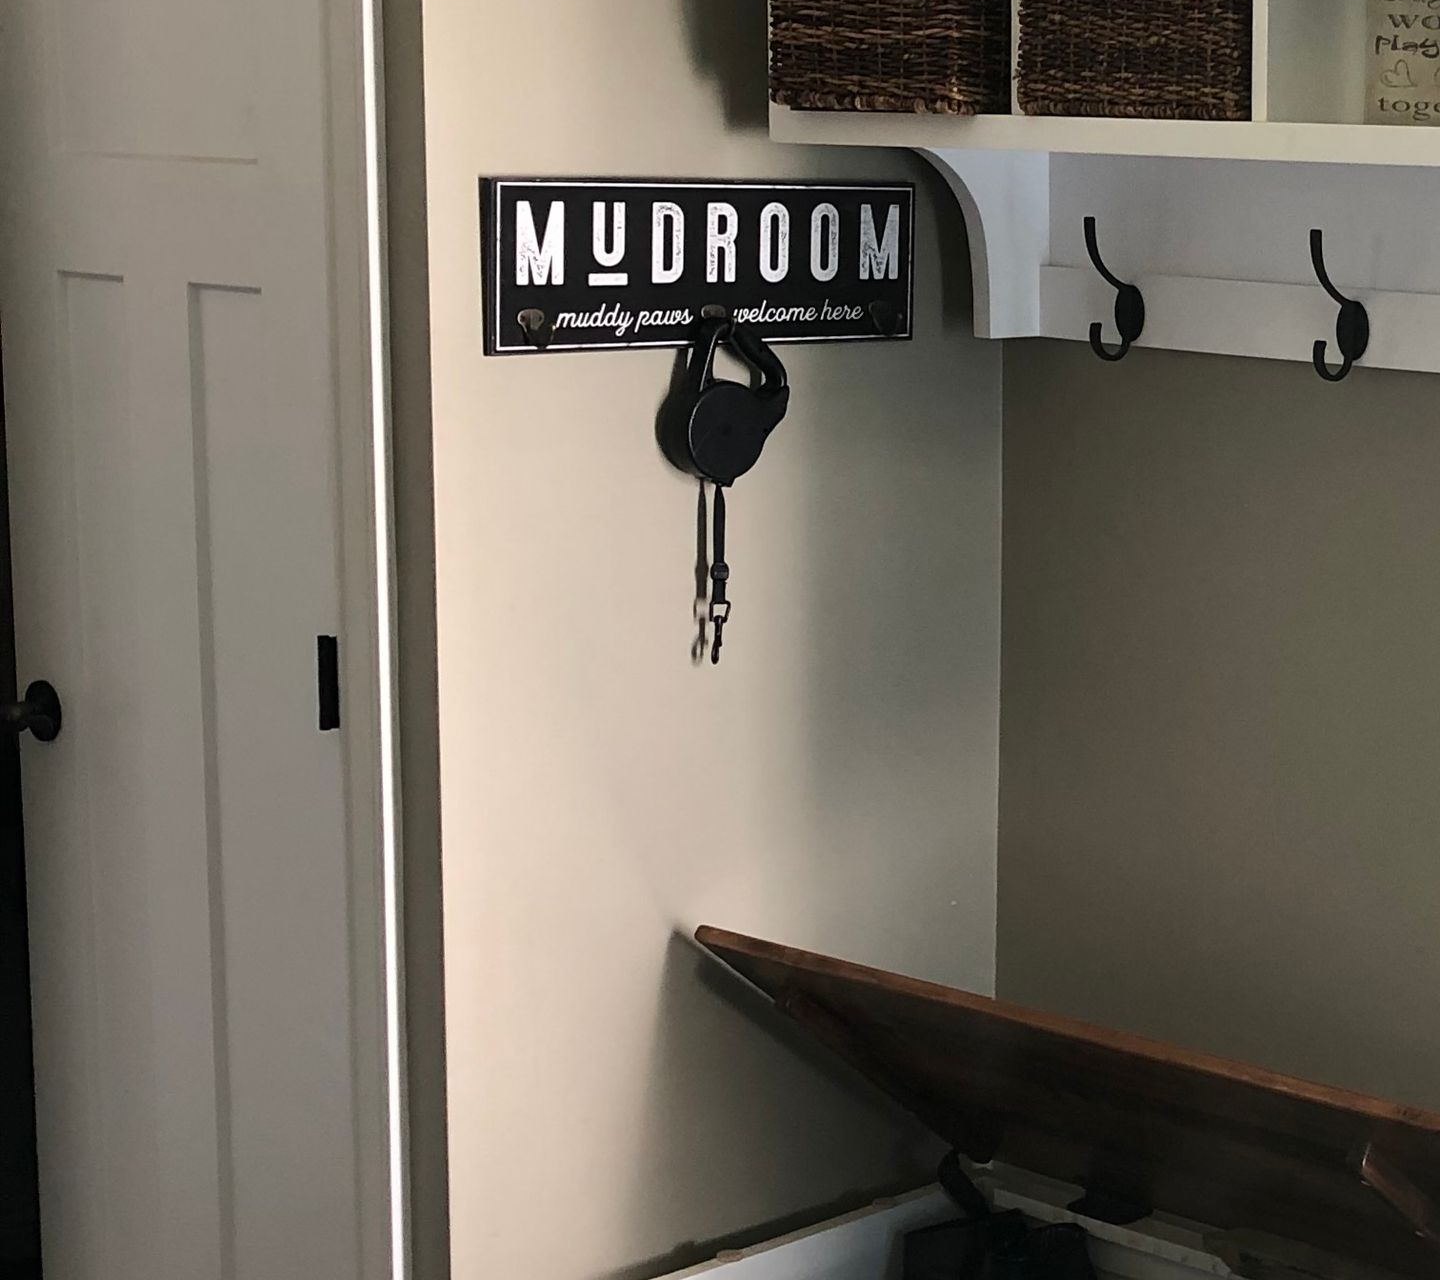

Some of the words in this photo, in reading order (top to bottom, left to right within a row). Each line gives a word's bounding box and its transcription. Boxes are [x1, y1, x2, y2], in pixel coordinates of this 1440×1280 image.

[515, 200, 900, 287] MUDROOM
[556, 302, 634, 337] muddy
[634, 308, 694, 334] paws
[733, 300, 819, 323] welcome
[820, 298, 864, 321] here
